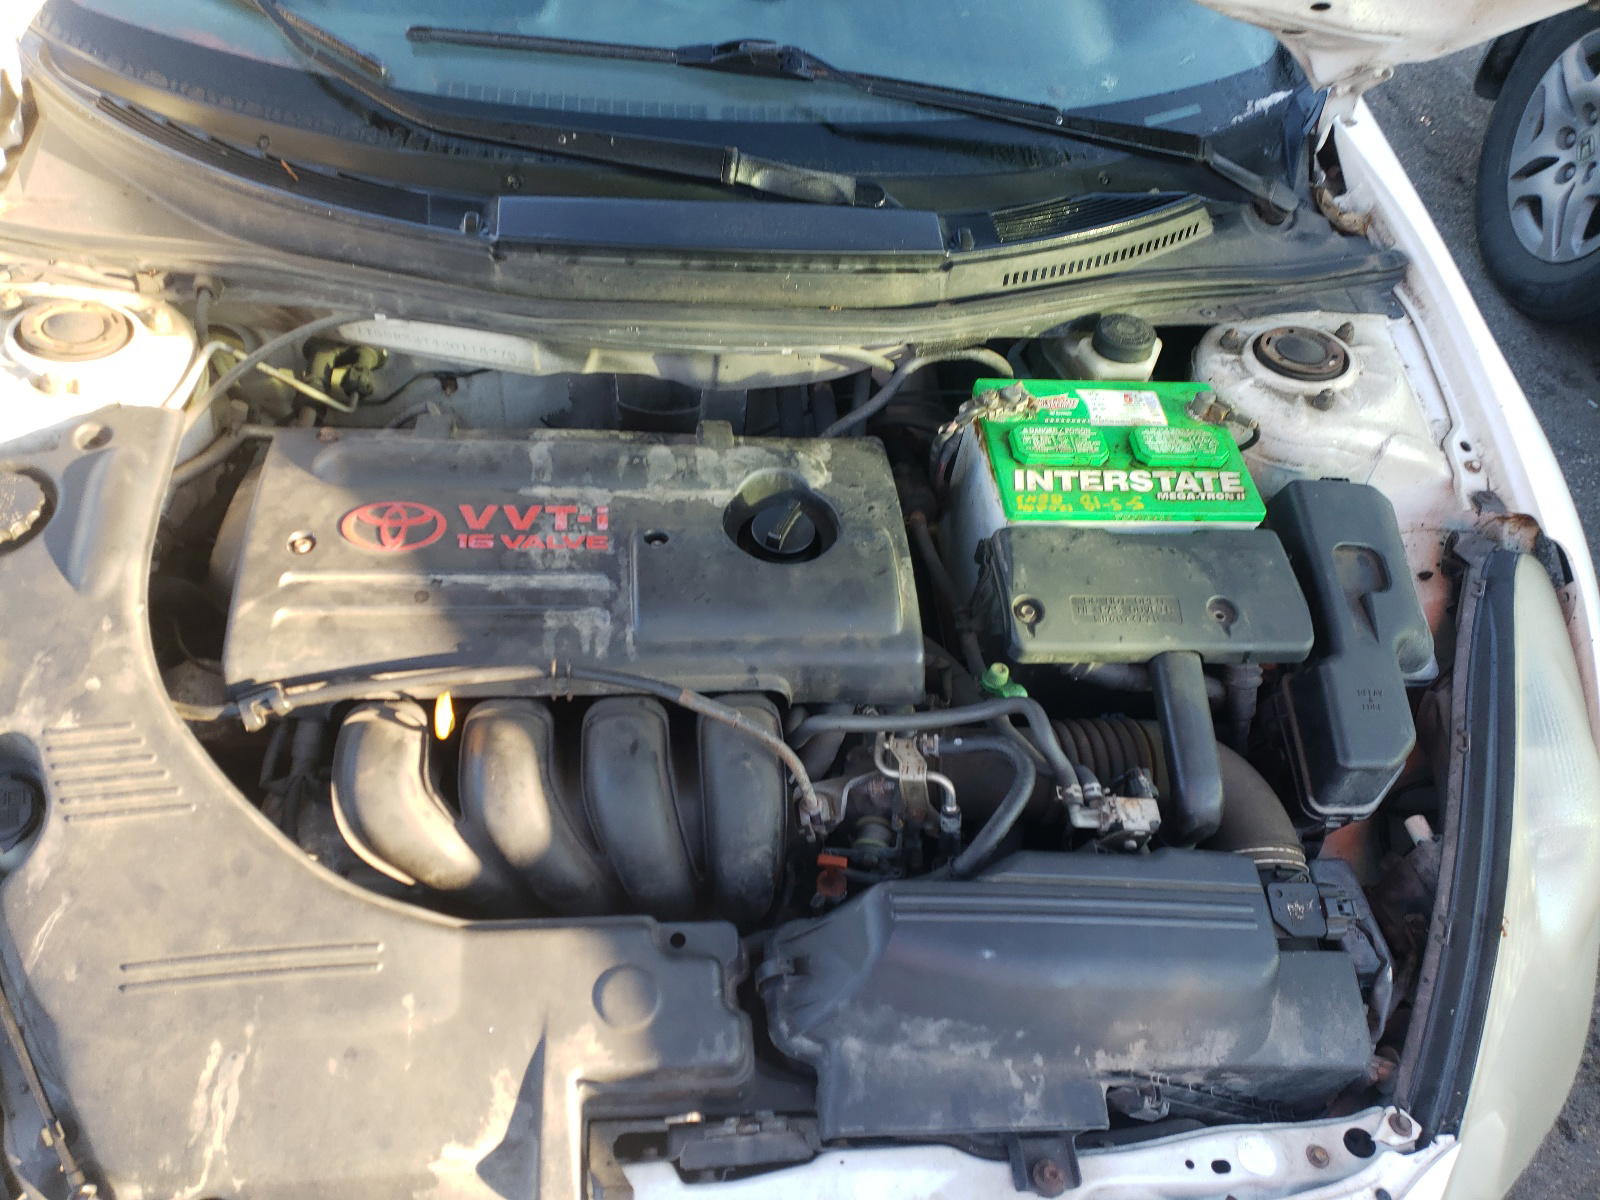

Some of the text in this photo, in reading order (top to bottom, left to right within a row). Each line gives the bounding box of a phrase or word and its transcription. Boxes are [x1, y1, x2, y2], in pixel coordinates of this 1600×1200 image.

[1014, 470, 1245, 492] INTERSTATE
[459, 504, 609, 530] VVT-i
[457, 533, 609, 550] 16 VALVE
